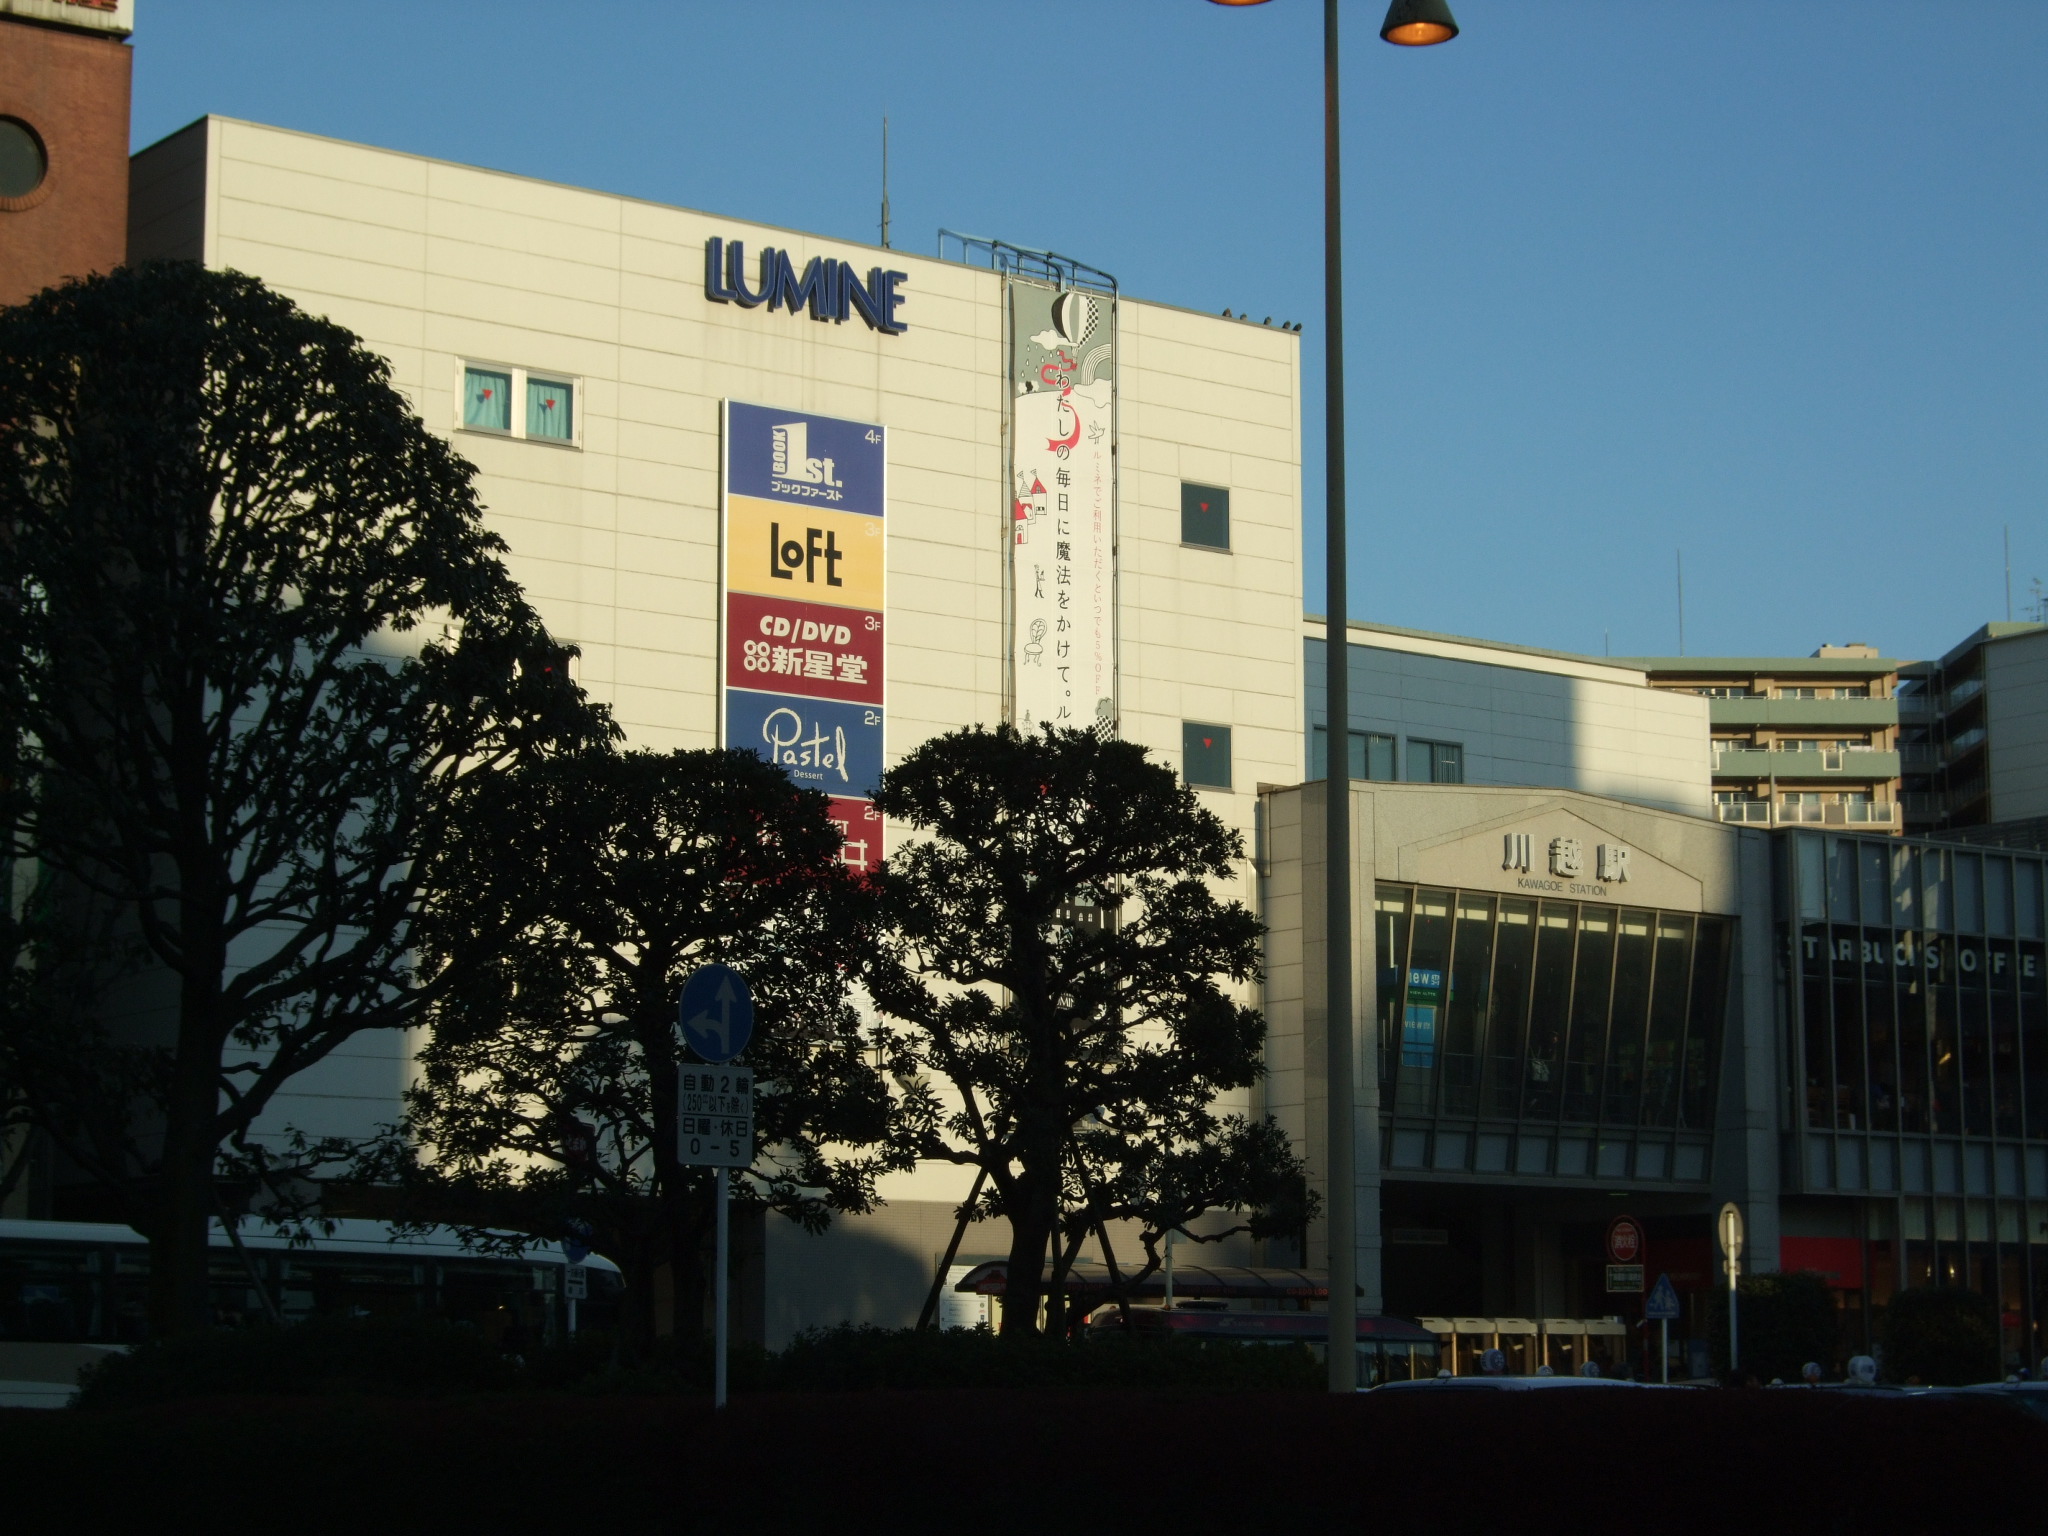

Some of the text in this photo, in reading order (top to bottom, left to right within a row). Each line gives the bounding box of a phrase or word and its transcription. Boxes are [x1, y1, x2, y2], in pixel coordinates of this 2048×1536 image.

[704, 236, 908, 335] LUMINE
[864, 429, 881, 445] 4F
[772, 428, 786, 474] BOOK
[771, 480, 843, 501] ブックファースト
[759, 615, 852, 645] CD/DVD
[864, 616, 881, 631] 3F
[771, 645, 868, 685] 新星堂
[864, 710, 881, 726] 2F
[762, 707, 849, 783] Pastel
[793, 769, 824, 781] Dessert
[864, 805, 881, 822] 2F
[1502, 832, 1632, 884] 川越駅
[1517, 877, 1607, 897] KAWAGOE STATION
[683, 1074, 749, 1095] 自動2輪
